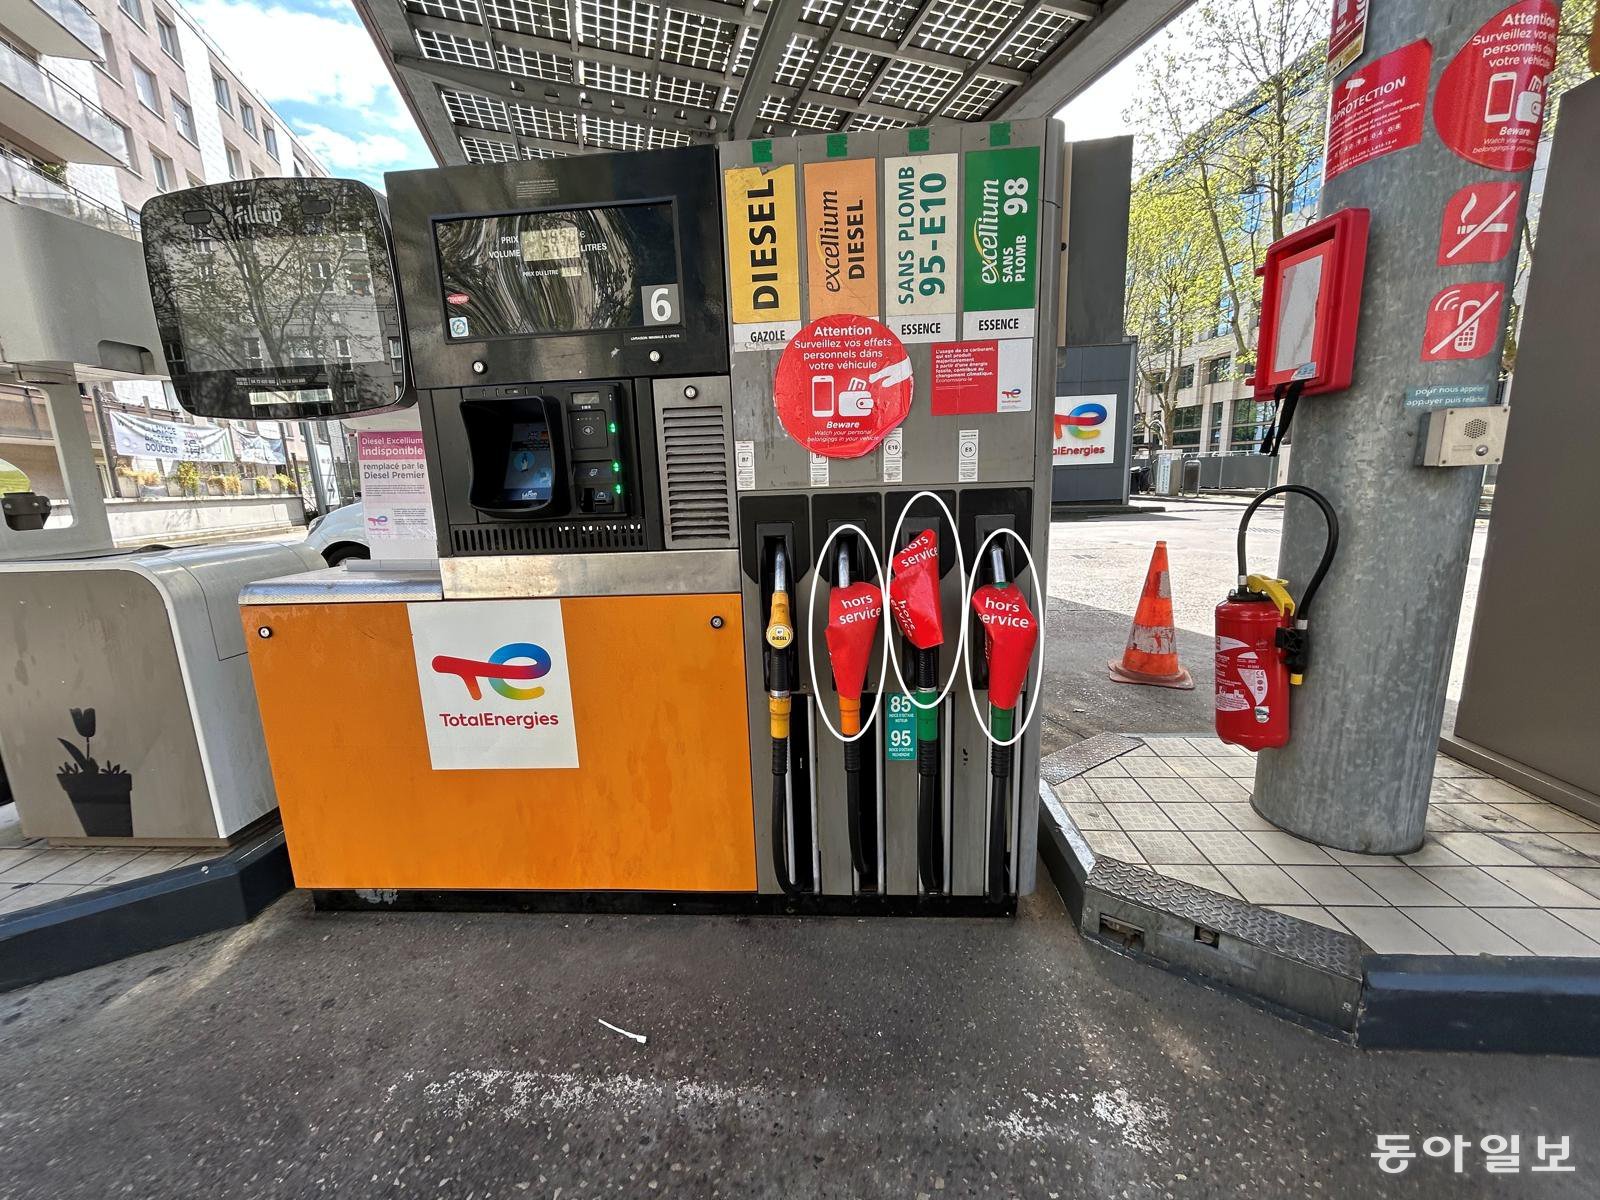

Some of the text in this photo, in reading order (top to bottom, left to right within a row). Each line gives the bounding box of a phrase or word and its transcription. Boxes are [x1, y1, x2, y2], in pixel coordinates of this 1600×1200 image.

[1472, 28, 1532, 46] Surveillez
[1482, 42, 1542, 58] personnels
[1489, 56, 1520, 67] votre
[1004, 177, 1028, 216] 98
[847, 199, 866, 280] DIESEL
[898, 166, 915, 304] SANS PLOMB
[919, 172, 946, 297] 95-E10
[975, 178, 999, 285] excellium
[748, 178, 780, 310] DIESEL
[820, 190, 841, 294] excellium
[489, 250, 520, 259] VOLUME
[580, 243, 607, 252] LITRES
[1014, 235, 1027, 282] PLOMB
[1003, 246, 1013, 283] SANS
[651, 288, 672, 322] 6
[814, 326, 872, 337] Attention
[901, 323, 941, 336] ESSENCE
[978, 318, 1019, 331] ESSENCE
[750, 330, 786, 344] GAZOLE
[794, 340, 841, 349] Surveillez
[864, 338, 892, 346] effets
[803, 349, 883, 361] personnels dans
[809, 361, 877, 370] votre véhicule
[1415, 388, 1437, 396] pour
[1406, 398, 1444, 406] appuyer
[145, 443, 178, 454] DOUCEUR
[362, 446, 423, 456] indisponible
[364, 463, 399, 471] remplacé
[841, 595, 873, 609] hors
[985, 597, 1020, 612] hors
[839, 607, 881, 624] service
[890, 696, 911, 712] 85
[439, 712, 558, 729] TotalEnergies
[890, 730, 911, 746] 95
